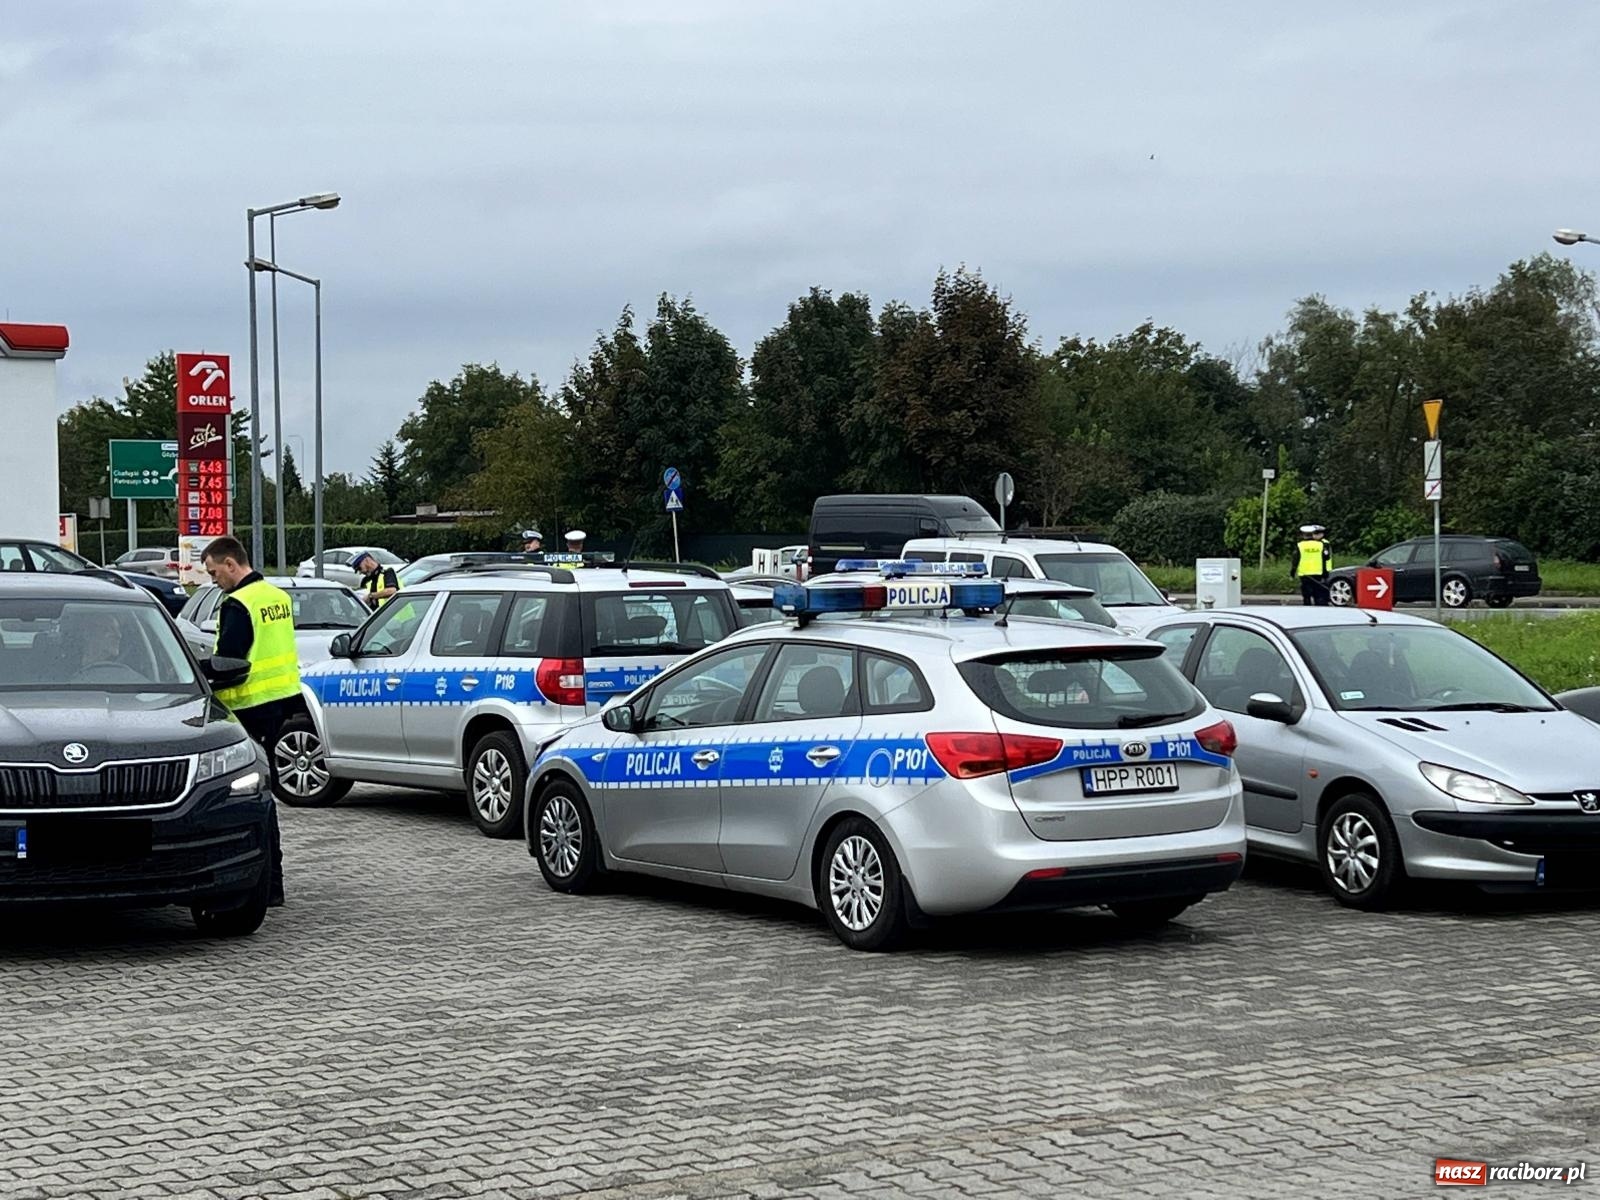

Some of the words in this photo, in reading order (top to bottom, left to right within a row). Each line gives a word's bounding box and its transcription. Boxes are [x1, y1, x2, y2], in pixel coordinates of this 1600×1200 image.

[189, 395, 227, 406] ORLEN
[889, 587, 949, 605] POLICJA
[339, 677, 382, 697] POLICJA
[494, 674, 515, 690] P118
[623, 673, 656, 686] POLIC
[1072, 749, 1112, 760] POLICJA
[1127, 744, 1146, 755] KIA
[1167, 741, 1191, 758] P101
[626, 752, 681, 776] POLICJA
[893, 749, 928, 770] P101
[1093, 769, 1130, 791] HPP
[1135, 767, 1175, 787] R001
